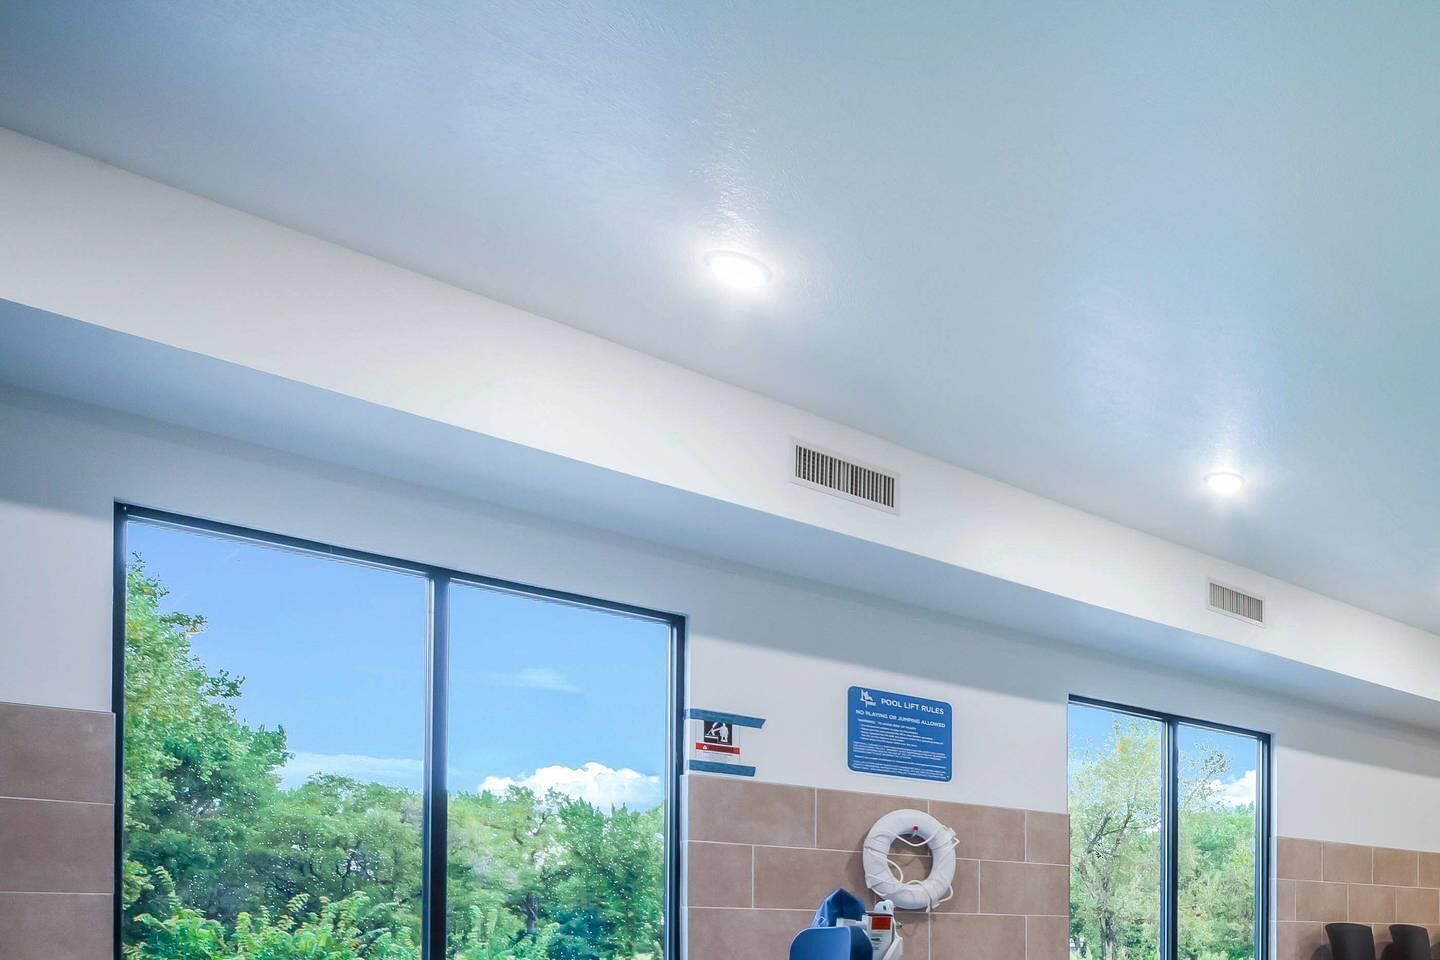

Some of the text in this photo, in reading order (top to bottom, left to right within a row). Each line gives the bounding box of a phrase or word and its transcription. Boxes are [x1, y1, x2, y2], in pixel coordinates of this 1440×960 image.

[881, 698, 945, 715] POOL LIFT RULES
[865, 710, 888, 719] PLAYING
[898, 716, 920, 724] JUMPING
[921, 719, 946, 728] ALLOWED
